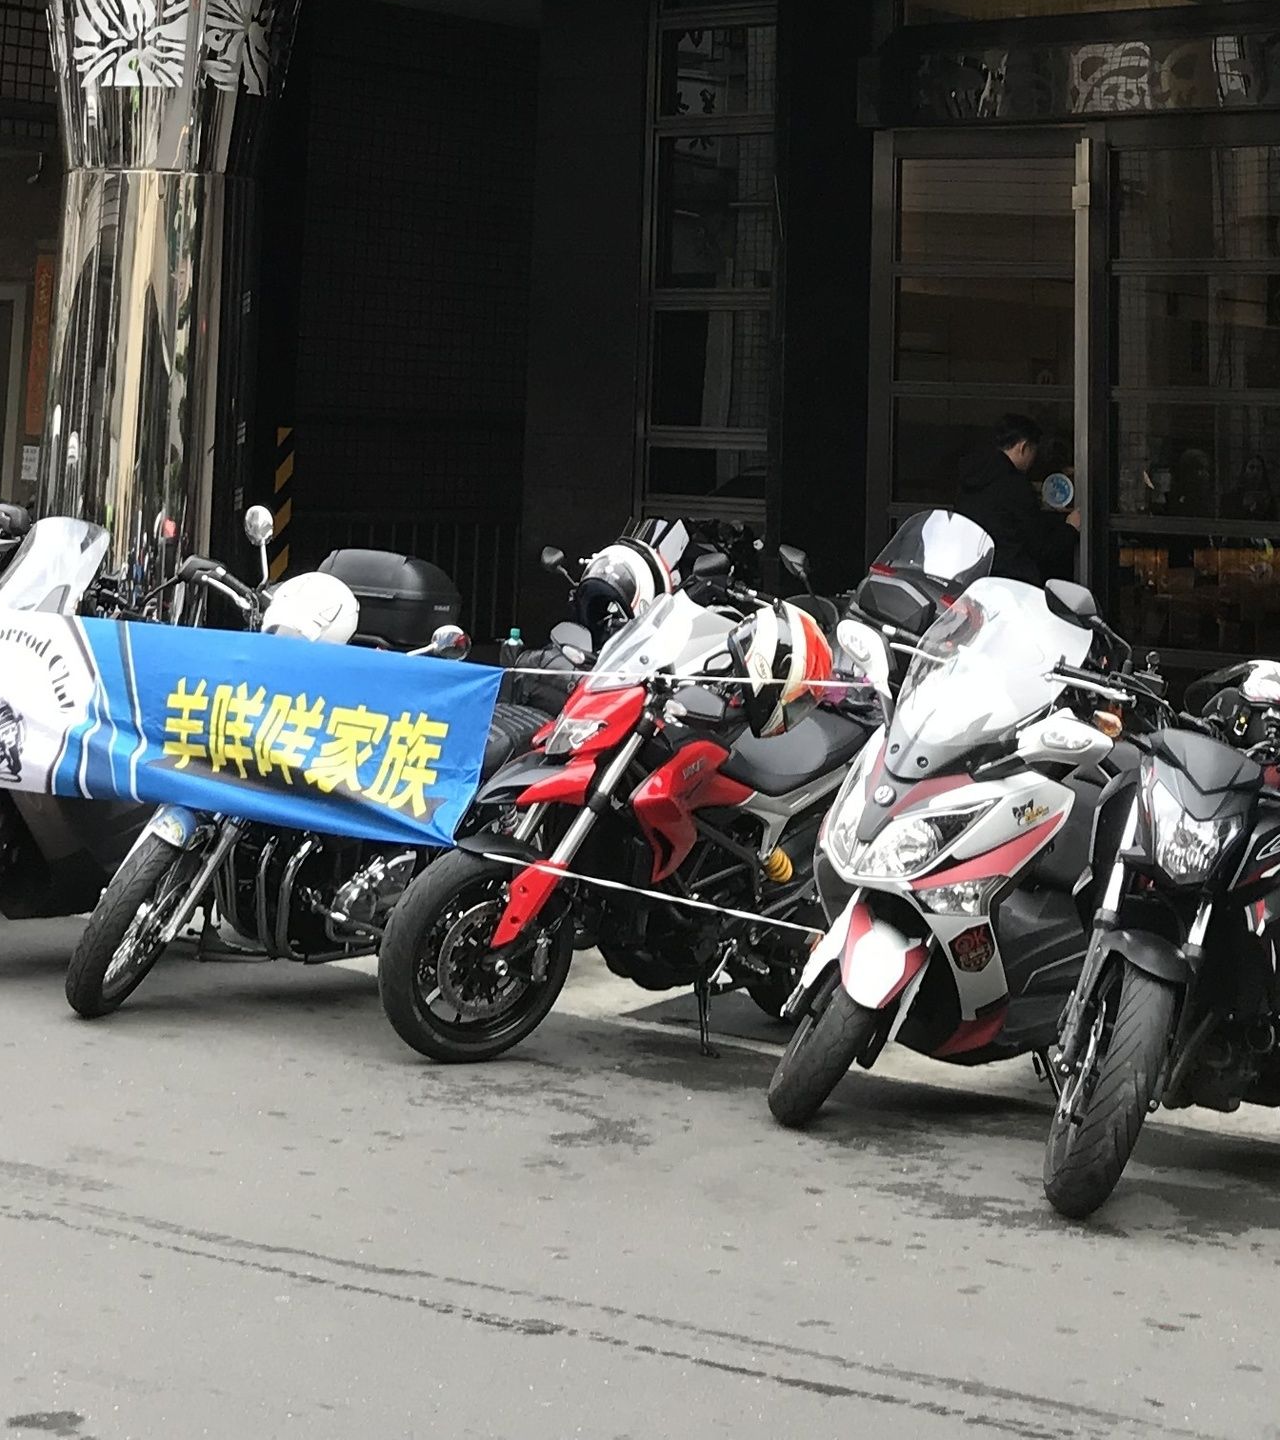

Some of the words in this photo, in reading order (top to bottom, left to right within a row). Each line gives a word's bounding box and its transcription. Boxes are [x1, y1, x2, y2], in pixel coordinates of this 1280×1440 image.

[162, 676, 450, 817] 羊咩咩家族
